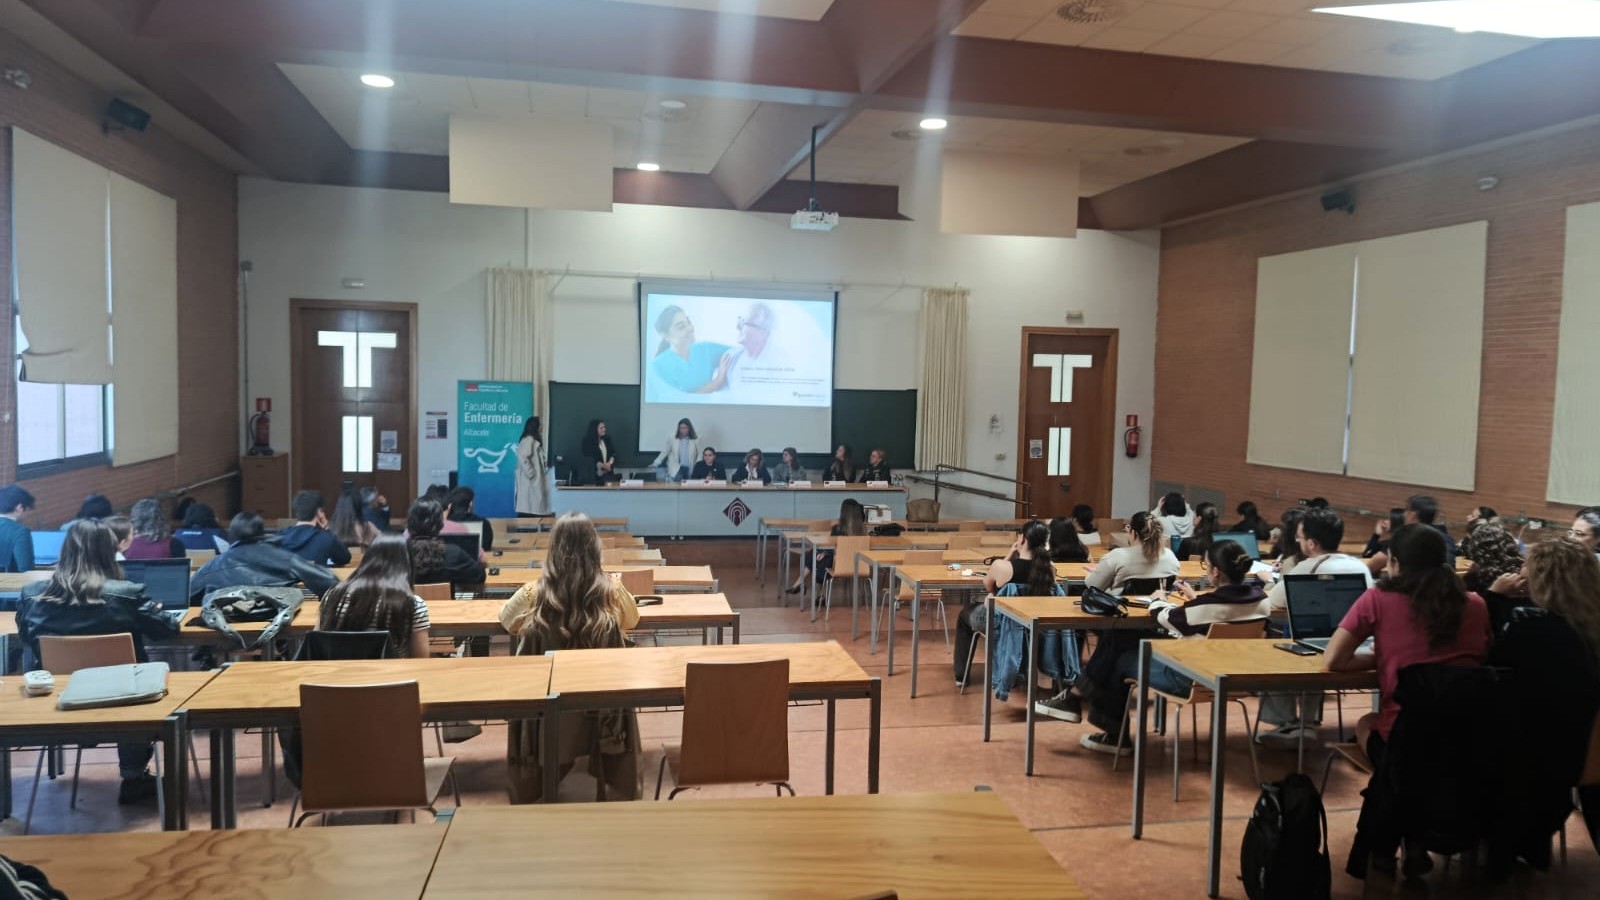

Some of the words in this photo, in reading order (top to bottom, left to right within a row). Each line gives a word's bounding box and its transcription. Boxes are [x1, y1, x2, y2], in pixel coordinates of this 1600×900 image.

[464, 401, 496, 411] Facultad
[498, 402, 508, 411] de
[464, 412, 522, 424] Enfermería
